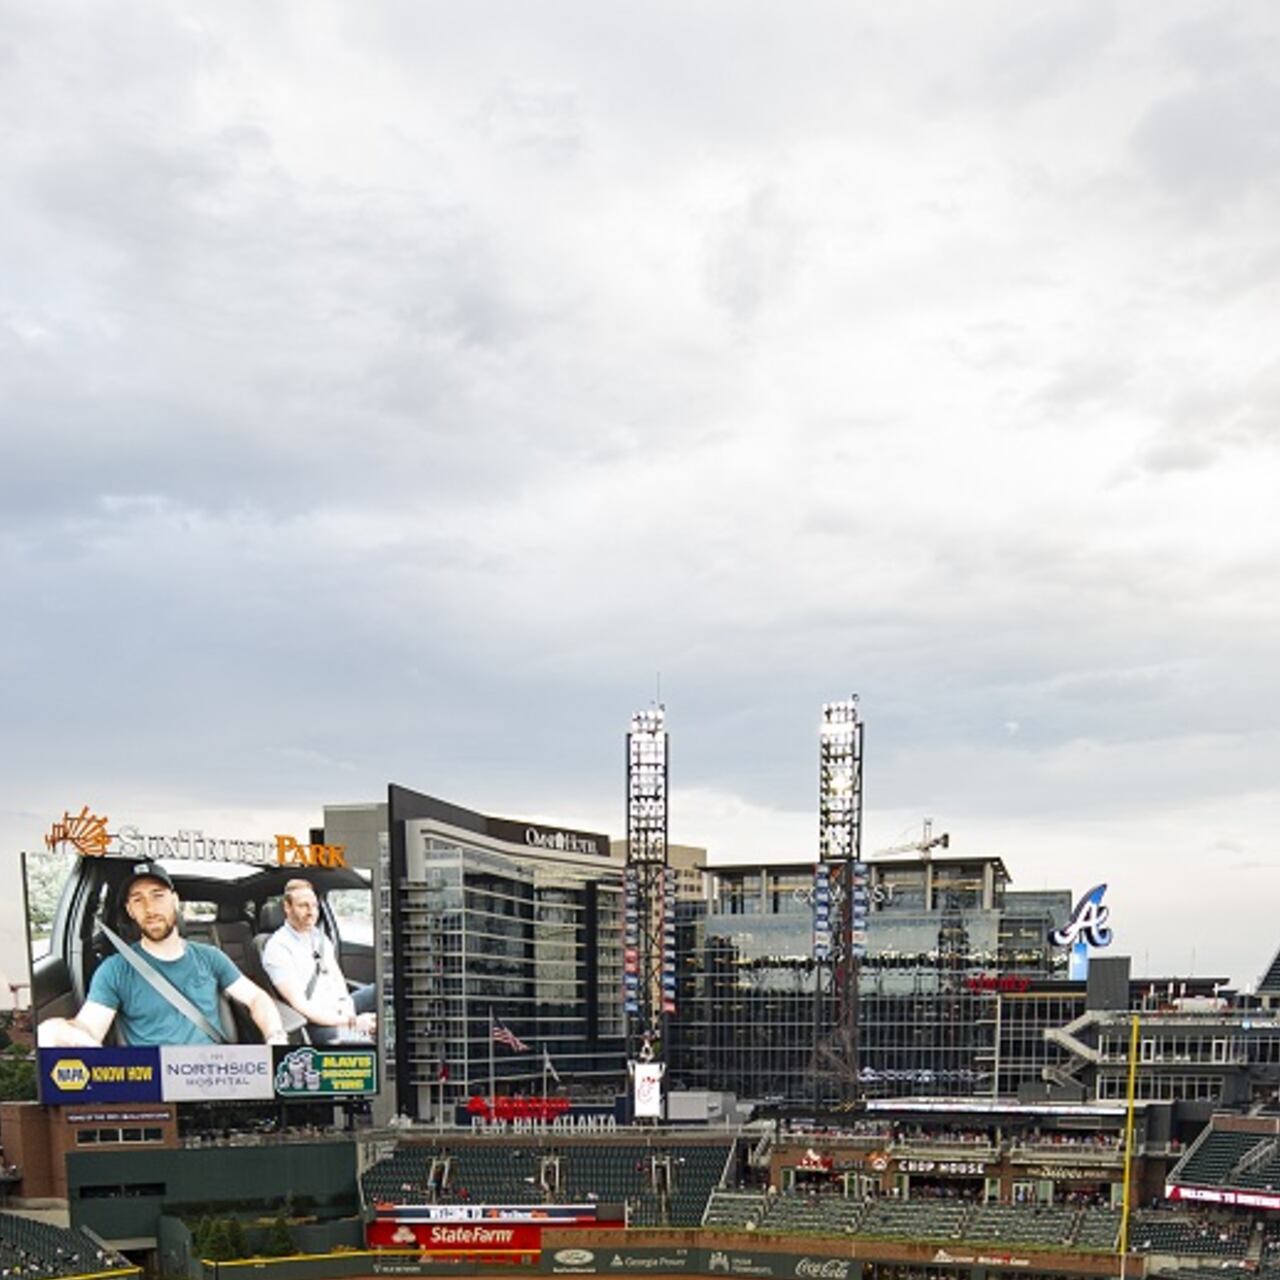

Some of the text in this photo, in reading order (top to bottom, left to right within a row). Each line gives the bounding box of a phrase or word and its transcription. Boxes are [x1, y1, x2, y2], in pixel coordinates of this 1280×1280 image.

[56, 1068, 85, 1082] NAPA
[167, 1062, 268, 1076] NORTHSIDE
[185, 1076, 250, 1087] HOSPITAL
[553, 1113, 617, 1134] ATLANTA
[938, 1162, 985, 1174] HOUSE
[624, 1256, 687, 1268] Georgia Power
